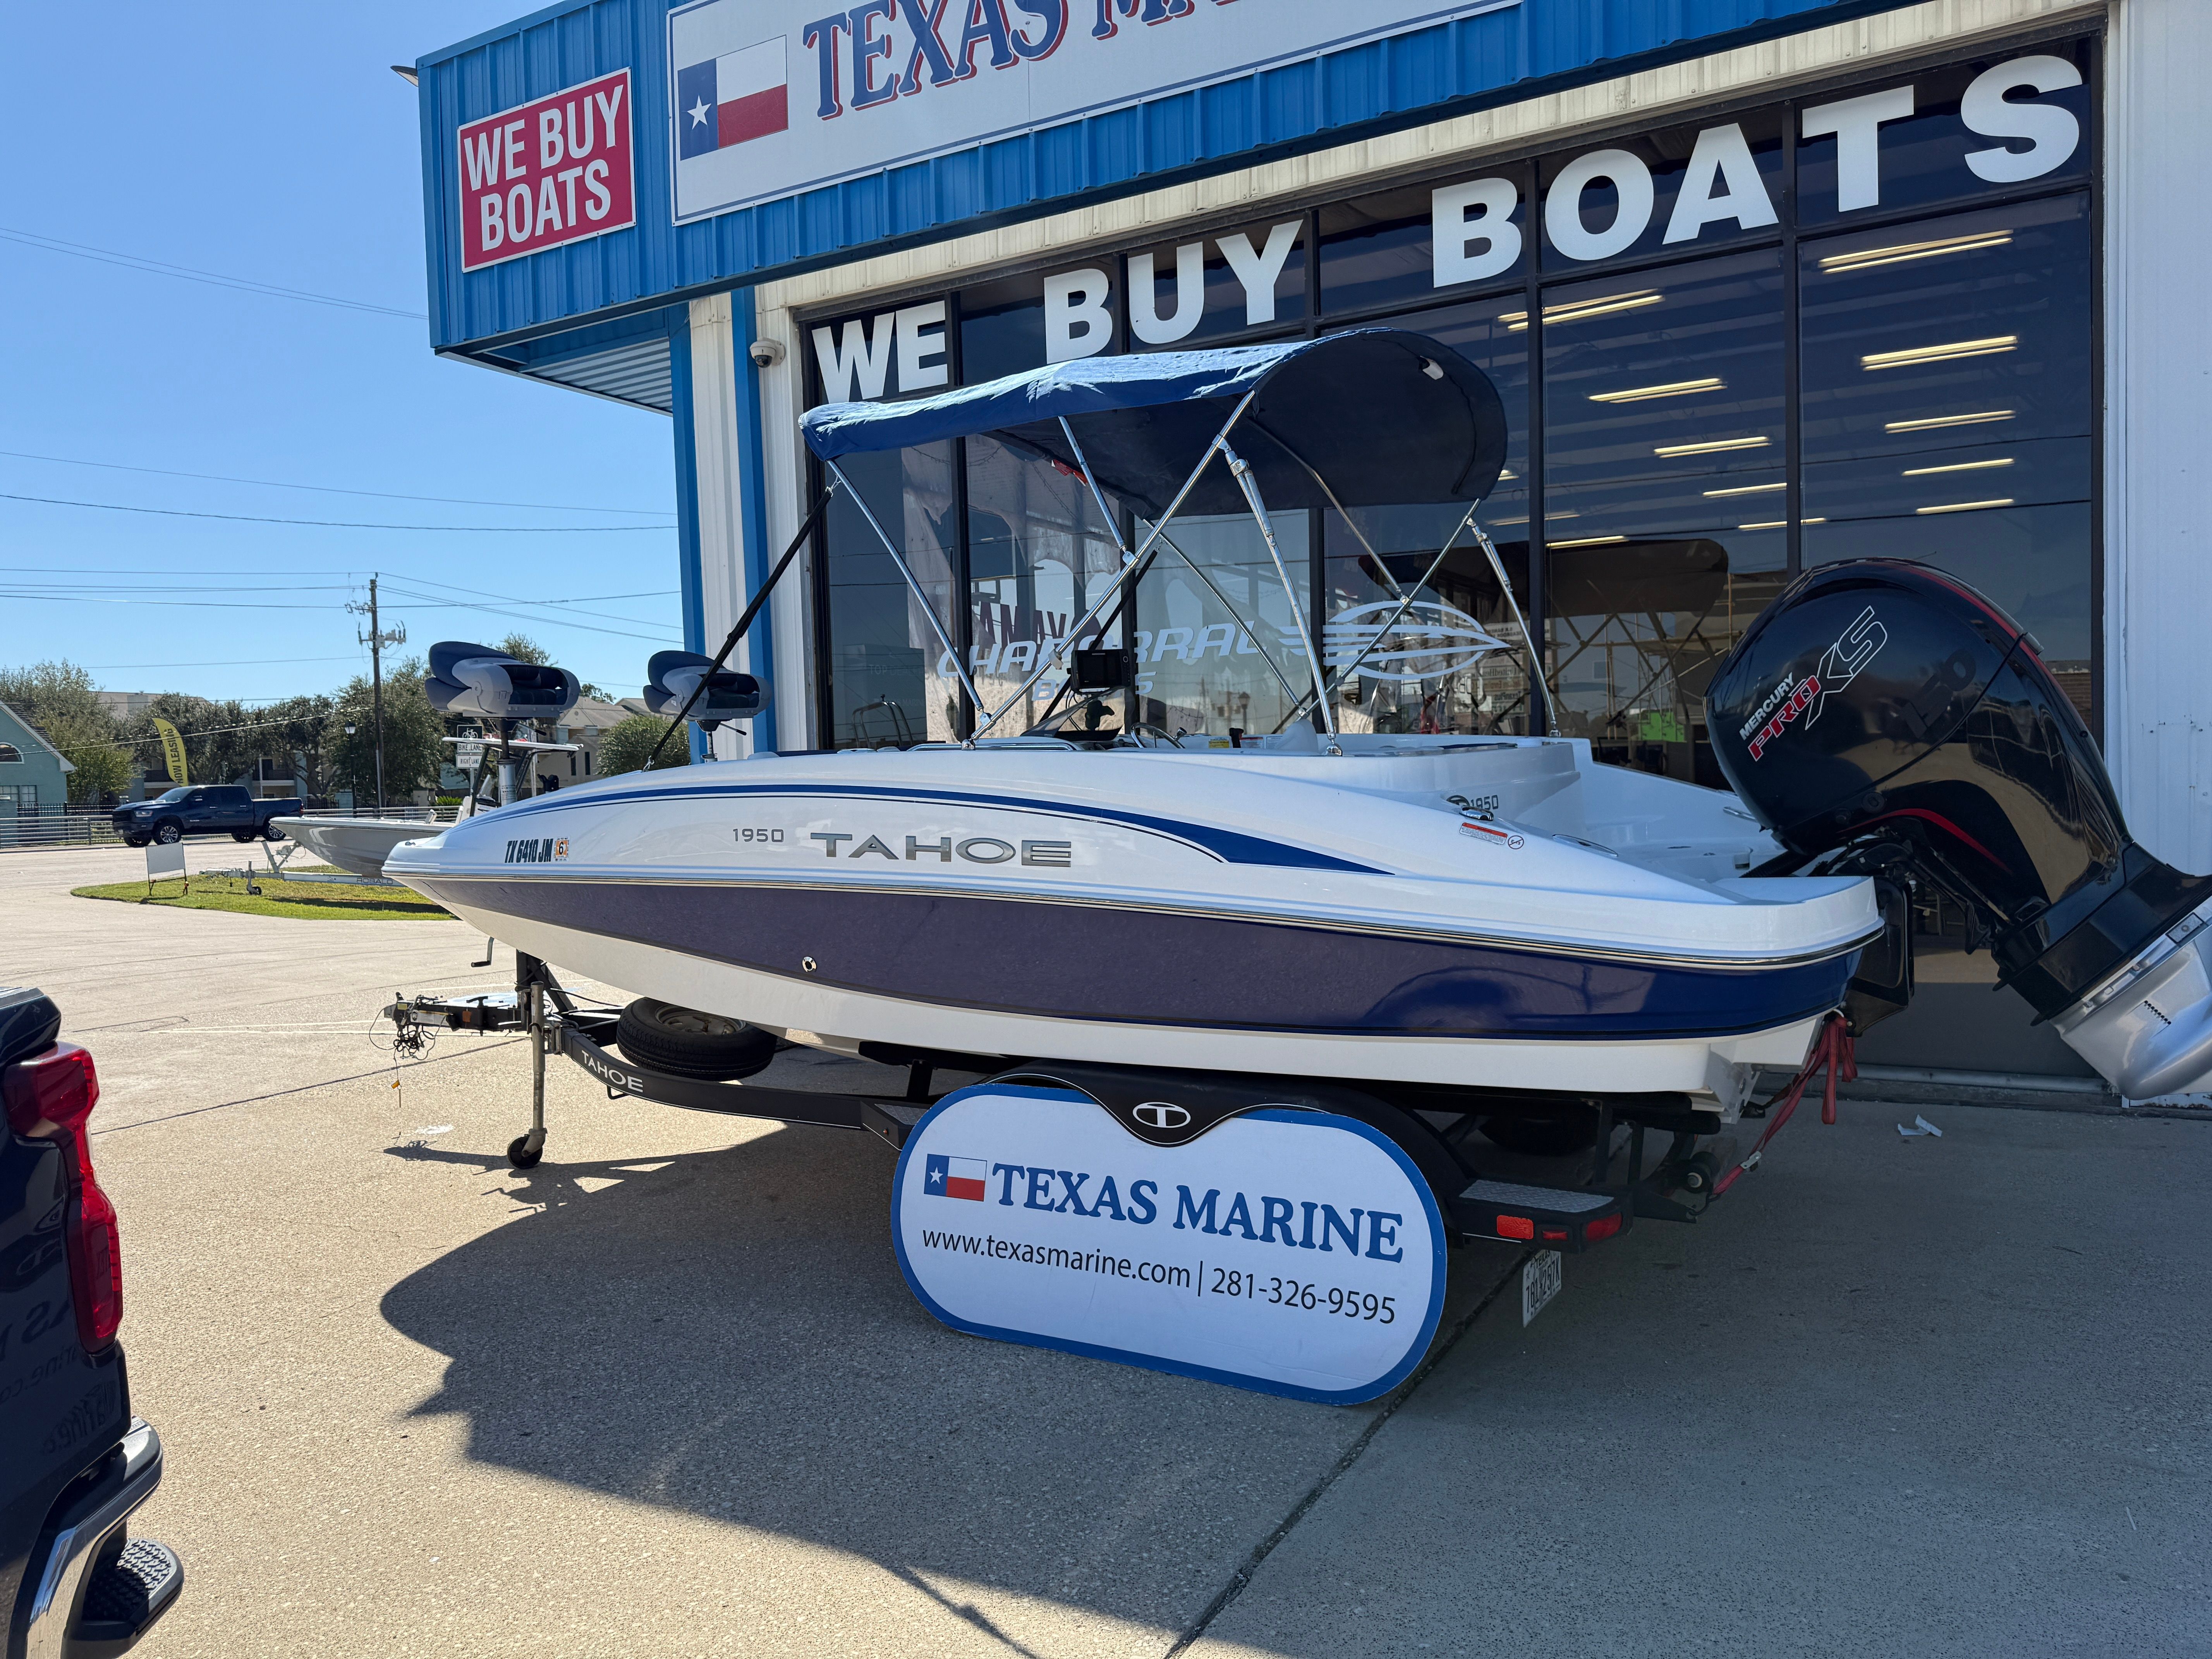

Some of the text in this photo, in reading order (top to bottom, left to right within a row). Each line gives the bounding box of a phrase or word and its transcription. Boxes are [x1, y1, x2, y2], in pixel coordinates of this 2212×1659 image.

[803, 0, 1069, 121] TEXAS
[464, 85, 623, 192] WE BUY
[481, 159, 611, 251] BOATS
[811, 55, 2083, 404] WE BUY BOATS
[1739, 672, 1795, 740] MERCURY
[164, 728, 184, 783] NOW LEASING
[1470, 795, 1499, 810] 1950
[505, 838, 553, 863] TX 6410 JM
[559, 842, 564, 855] 6
[733, 828, 1072, 867] 1950 TAHOE
[582, 1050, 643, 1092] TAHOE
[992, 1163, 1403, 1264] TEXAS MARINE
[922, 1229, 1191, 1289] www.texasmarine.com
[1211, 1267, 1396, 1325] 281-326-9595
